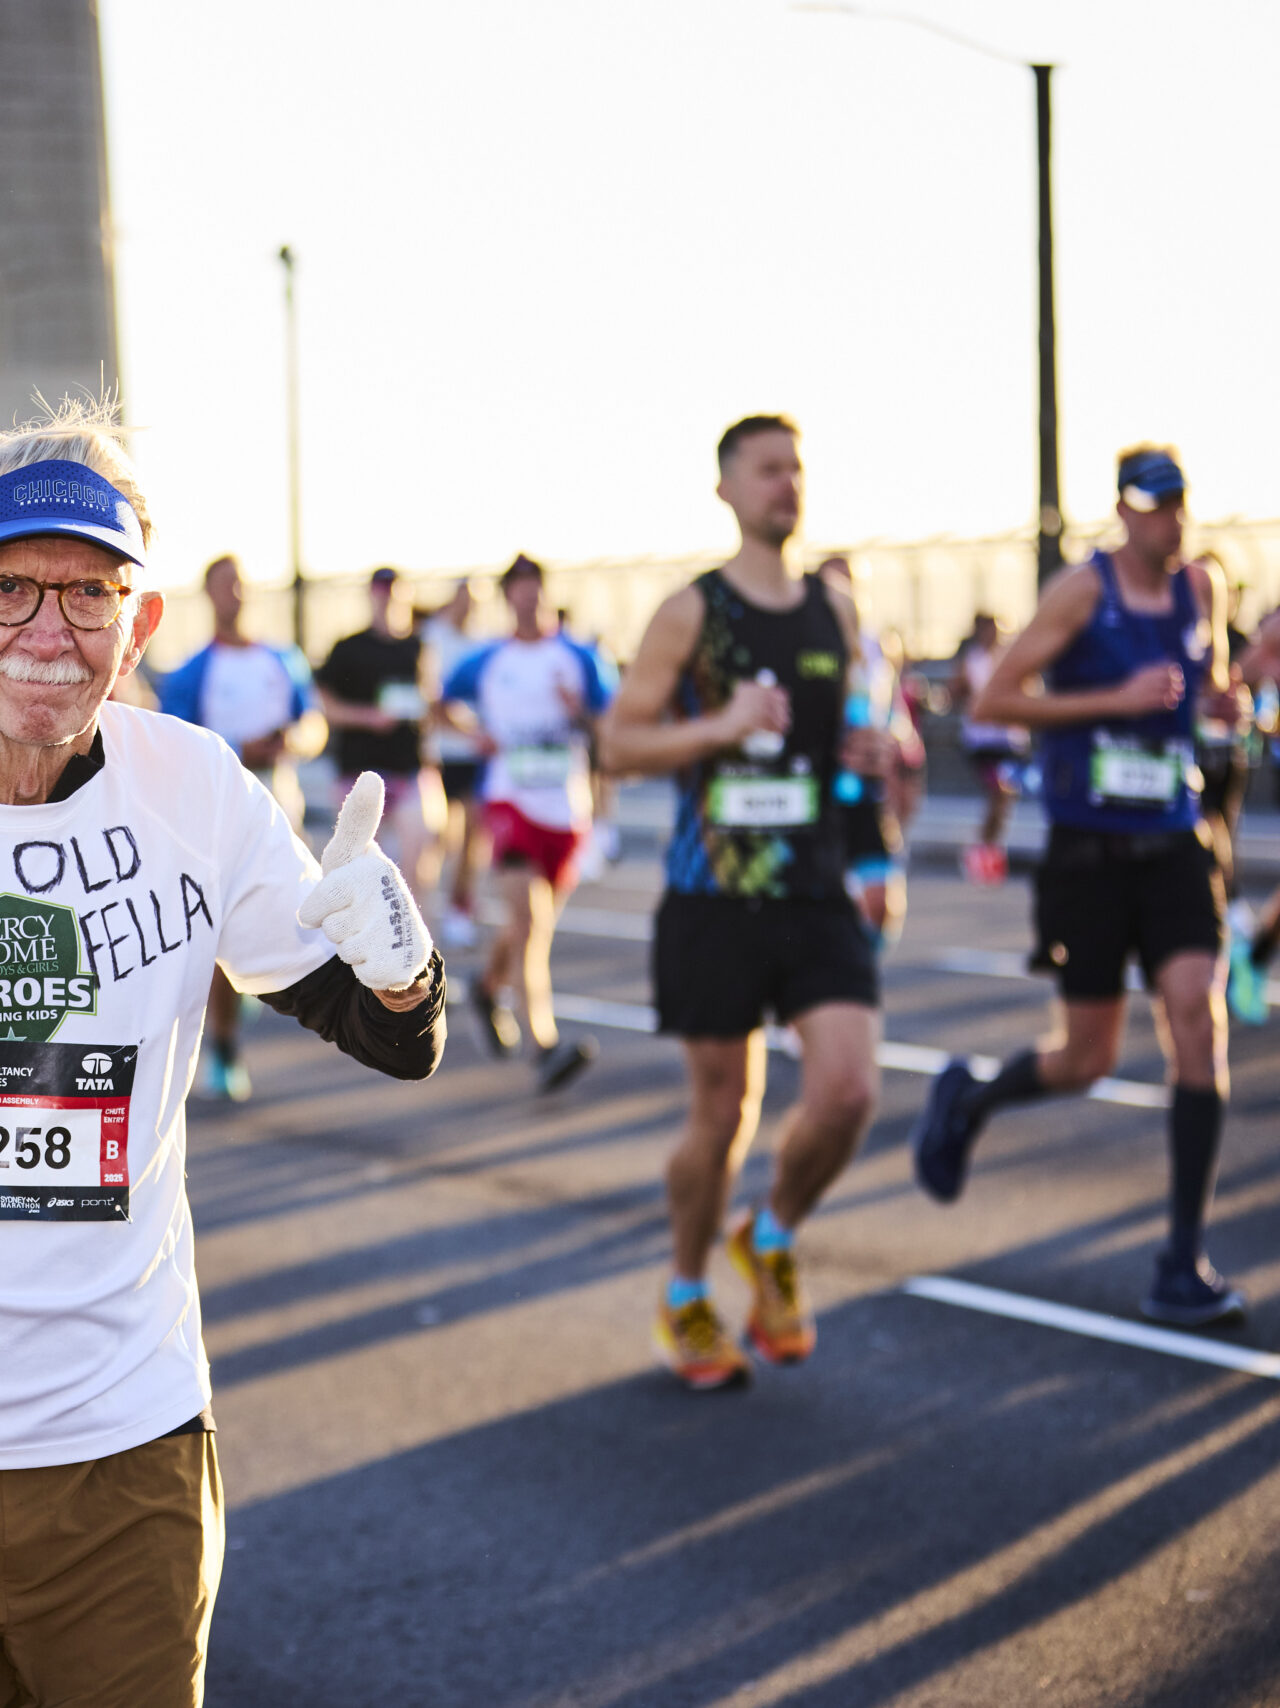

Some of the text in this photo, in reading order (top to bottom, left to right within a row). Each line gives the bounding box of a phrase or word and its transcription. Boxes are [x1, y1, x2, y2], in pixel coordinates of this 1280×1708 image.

[14, 479, 109, 507] CHICAGO
[12, 825, 142, 894] OLD
[381, 875, 403, 950] LaSalle
[79, 873, 213, 990] FELLA
[16, 964, 27, 975] &
[26, 961, 59, 974] GIRLS
[26, 1009, 58, 1021] KIDS
[75, 1078, 114, 1090] TATA
[2, 1097, 39, 1105] ASSEMBLY
[105, 1107, 126, 1115] CHUTE
[103, 1116, 125, 1124] ENTRY
[106, 1139, 119, 1160] B
[104, 1173, 124, 1183] 2025
[56, 1199, 74, 1207] asics
